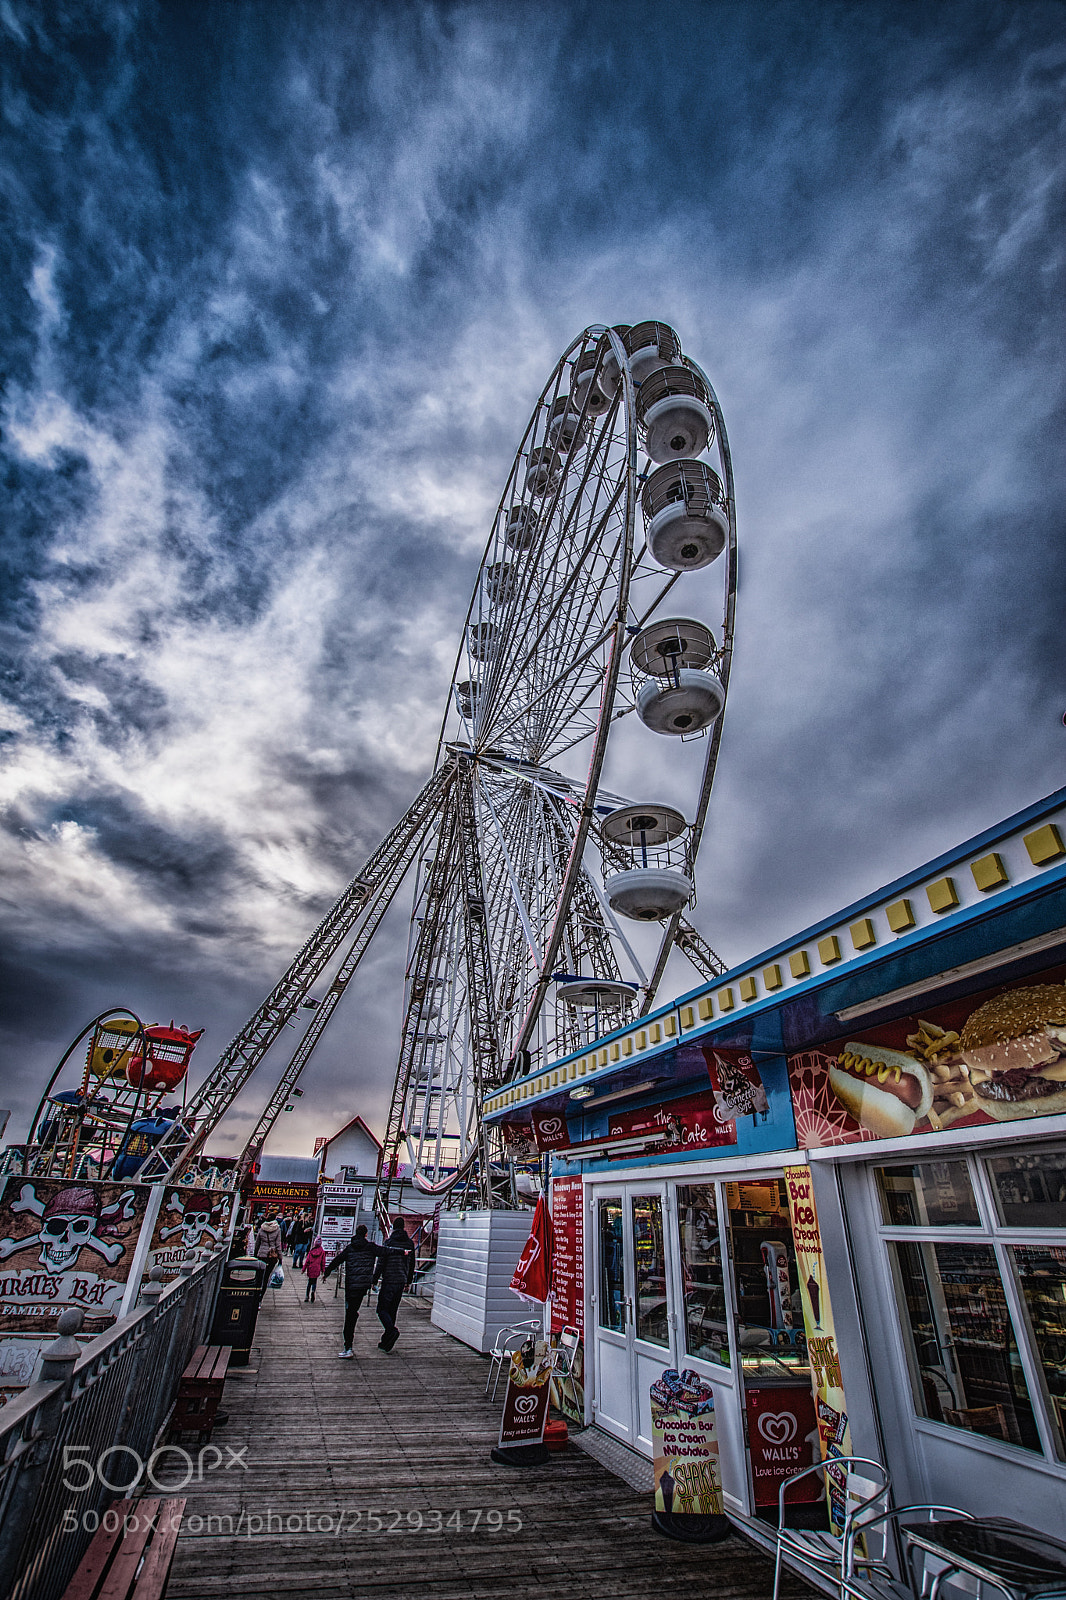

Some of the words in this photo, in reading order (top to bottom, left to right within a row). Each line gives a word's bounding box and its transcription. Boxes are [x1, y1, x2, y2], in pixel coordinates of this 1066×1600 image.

[726, 1089, 756, 1108] Cornetto
[738, 1100, 752, 1112] Soft
[542, 1132, 564, 1142] WALL'S
[681, 1123, 707, 1145] Cafe
[253, 1186, 309, 1196] AMUSEMENTS
[789, 1181, 810, 1200] Bar
[794, 1202, 814, 1225] Ice
[794, 1227, 820, 1241] Cream
[0, 1274, 64, 1299] IRATES
[68, 1278, 117, 1305] BAY
[1, 1306, 48, 1316] FAMILY
[513, 1414, 535, 1423] WALL'S
[654, 1418, 696, 1430] Chocolate
[698, 1421, 714, 1431] Bar
[664, 1432, 676, 1442] Ice
[678, 1433, 706, 1444] Cream
[663, 1444, 710, 1457] Milkshake
[762, 1447, 799, 1461] WALL'S
[673, 1459, 722, 1497] SHAKE
[755, 1466, 772, 1477] Love
[773, 1466, 784, 1476] ice
